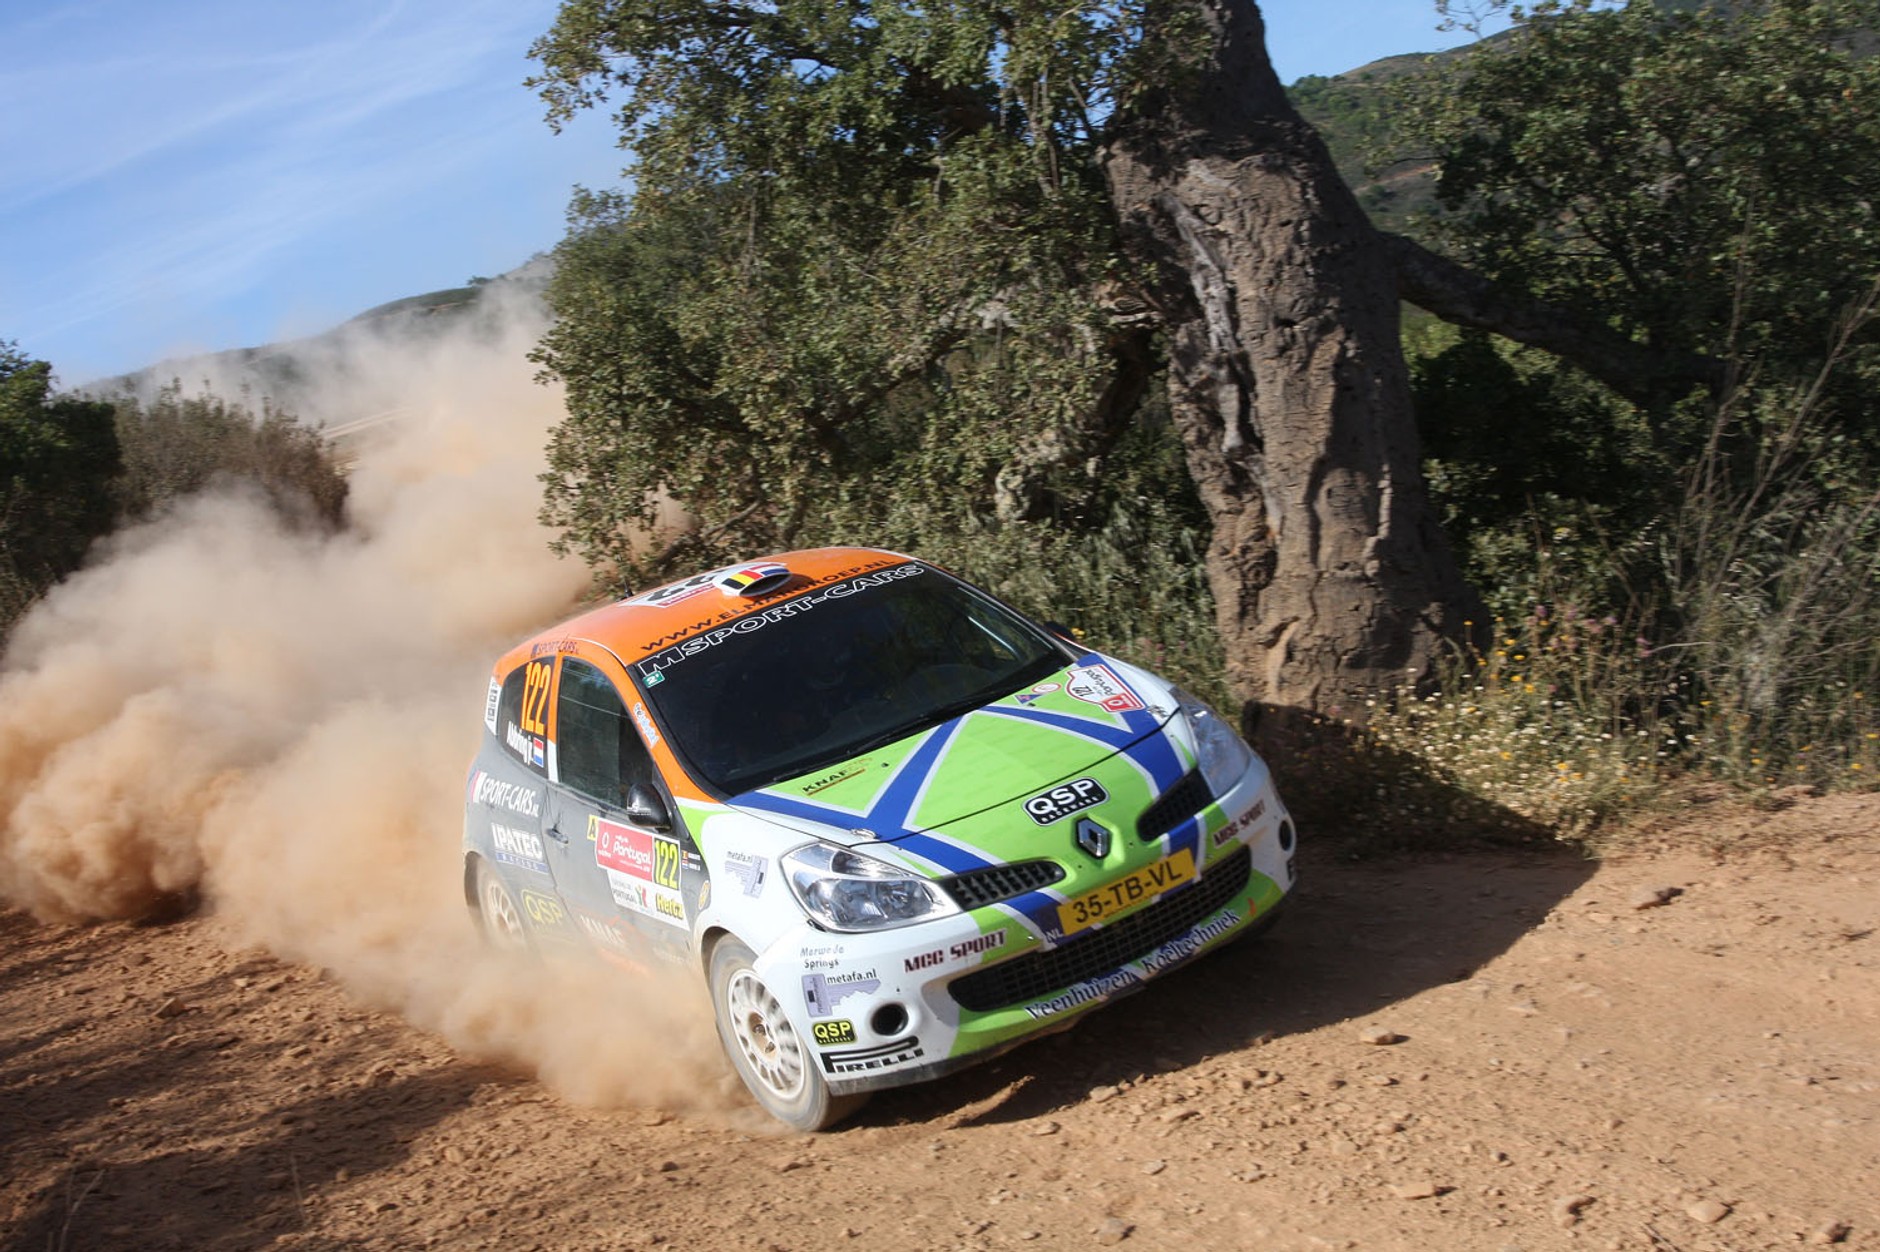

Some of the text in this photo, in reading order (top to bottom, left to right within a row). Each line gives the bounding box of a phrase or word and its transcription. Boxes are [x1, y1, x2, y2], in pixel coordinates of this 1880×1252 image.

[521, 661, 551, 736] 122
[1028, 778, 1094, 815] QSP
[491, 822, 543, 862] IPATEC
[612, 841, 651, 865] Portugal
[655, 839, 679, 891] 122
[656, 892, 684, 920] Hertz
[1072, 860, 1182, 924] 35-TB-VL
[950, 930, 1006, 960] SPORT
[827, 968, 877, 985] metafa.nl
[1025, 908, 1241, 1021] Veenhuizen Koeltechniek
[815, 1021, 851, 1039] QSP
[820, 1035, 925, 1074] PIRELLI
